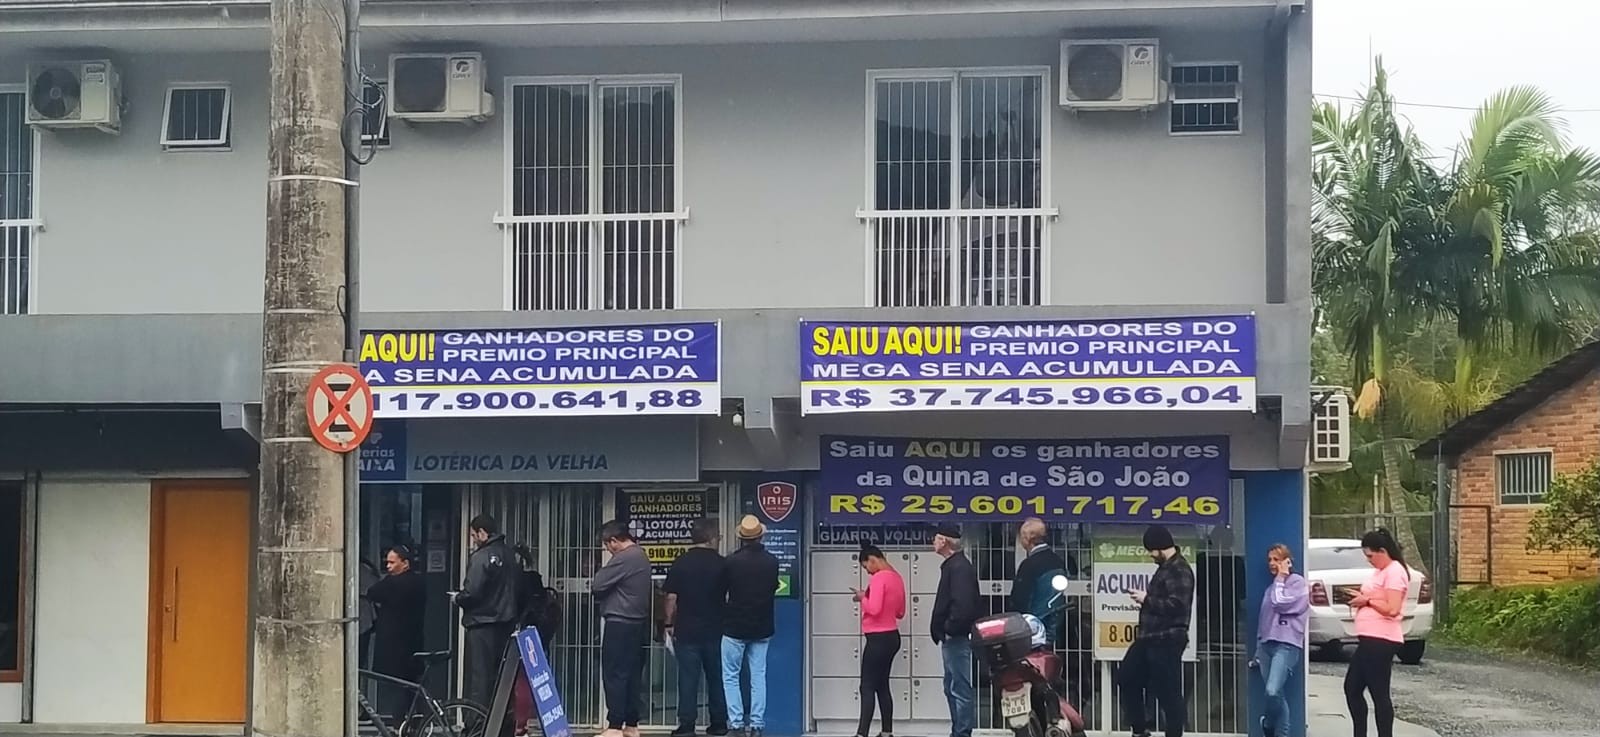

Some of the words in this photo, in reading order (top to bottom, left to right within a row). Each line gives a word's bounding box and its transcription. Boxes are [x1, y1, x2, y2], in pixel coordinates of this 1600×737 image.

[443, 328, 644, 345] GANHADORES
[653, 328, 695, 342] DO
[970, 322, 1182, 339] GANHADORES
[1192, 321, 1237, 336] DO
[360, 333, 435, 363] AQUI!
[813, 326, 879, 356] SAIU
[884, 326, 962, 355] AQUI!
[970, 341, 1080, 356] PREMIO
[1088, 339, 1240, 354] PRINCIPAL
[443, 349, 547, 362] PREMIO
[555, 346, 698, 361] PRINCIPAL
[393, 368, 482, 383] SENA
[489, 365, 699, 382] ACUMULADA
[812, 363, 911, 378] MEGA
[919, 361, 1012, 377] SENA
[1019, 359, 1242, 376] ACUMULADA
[810, 387, 872, 409] R$
[889, 385, 1243, 409] 37.745.966,04
[359, 446, 395, 457] erias
[829, 441, 894, 458] Saiu
[904, 440, 981, 458] AQUI
[992, 445, 1027, 458] os
[1037, 441, 1220, 462] ganhadores
[510, 454, 539, 470] DA
[547, 454, 609, 470] VELHA
[856, 470, 893, 487] da
[902, 464, 990, 487] Quina
[1000, 470, 1037, 487] de
[1047, 465, 1104, 487] São
[1115, 465, 1191, 487] João
[630, 495, 655, 503] SAIU
[658, 494, 684, 502] AQUI
[687, 494, 702, 502] OS
[762, 496, 792, 505] IRIS
[830, 494, 886, 516] R$
[900, 495, 1220, 518] 25.601.717,46
[630, 503, 702, 513] GANHADORES
[820, 531, 879, 542] GUARDA
